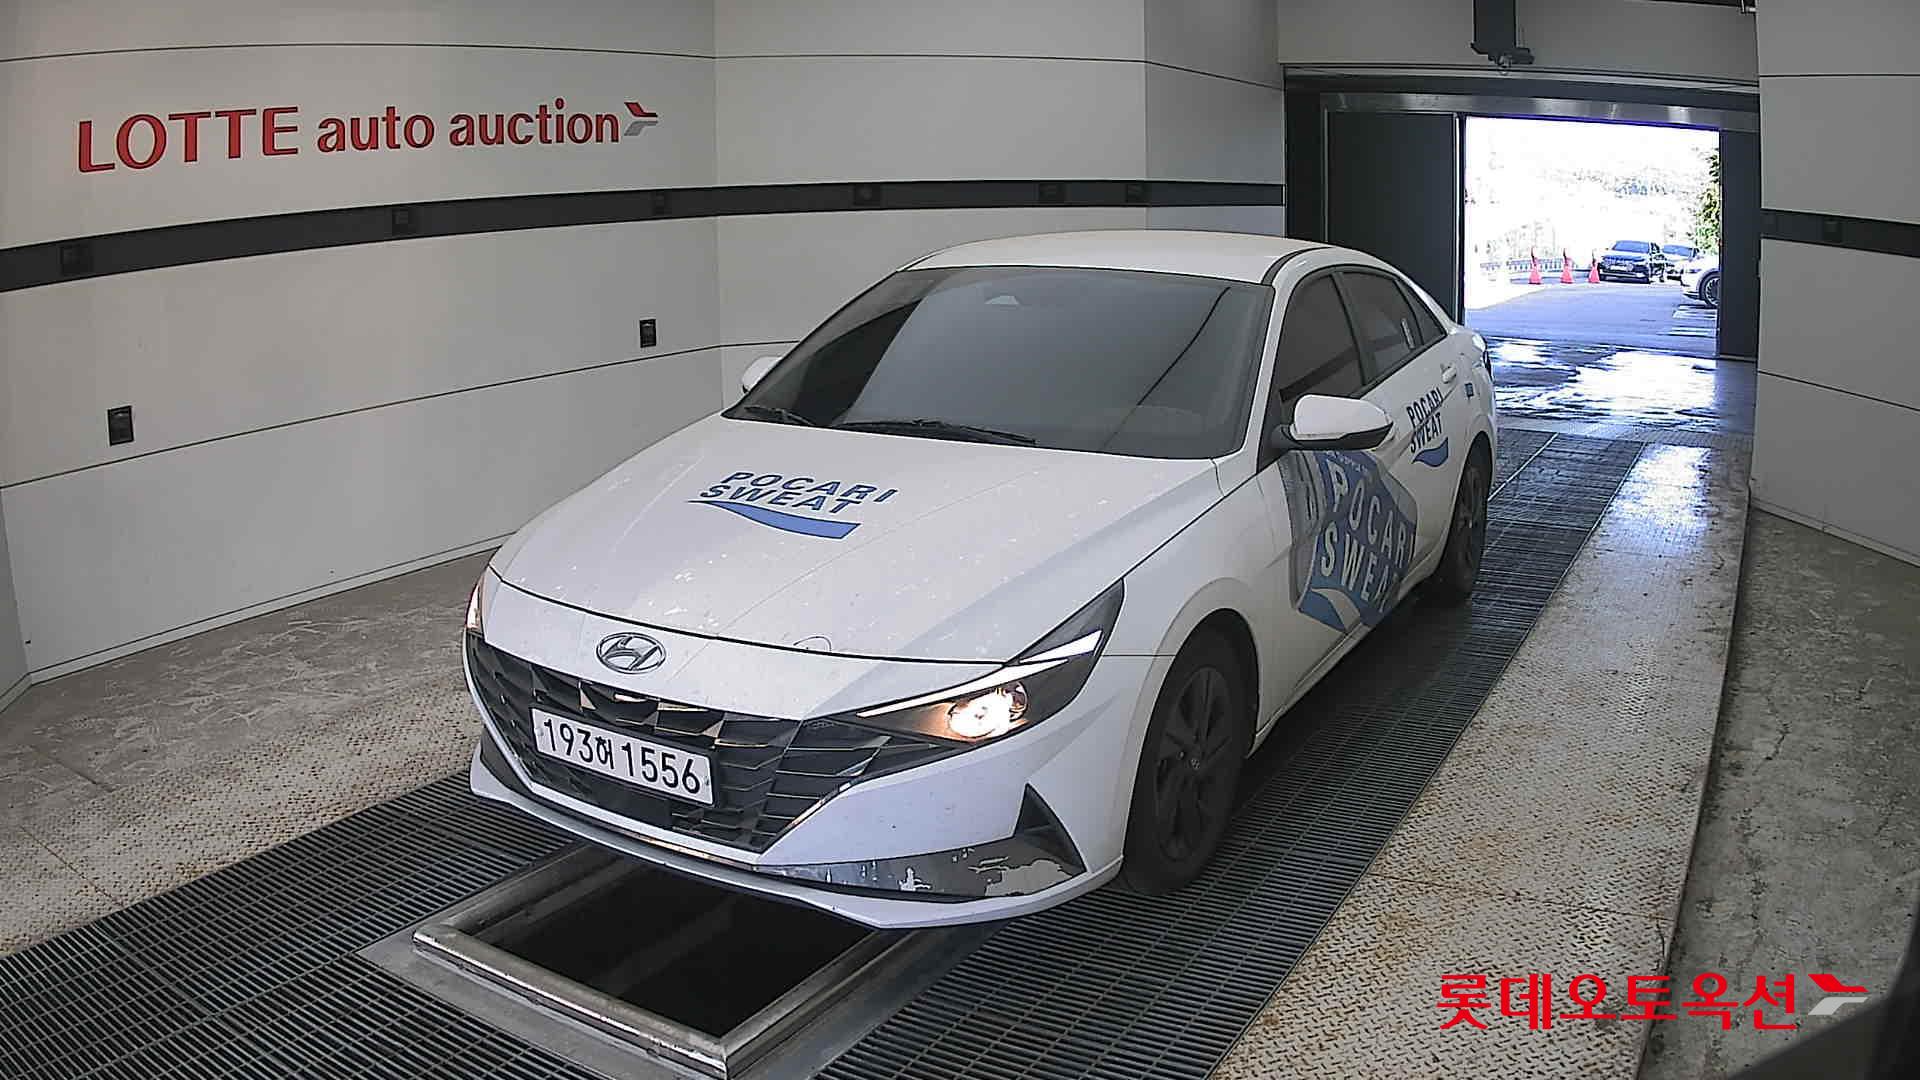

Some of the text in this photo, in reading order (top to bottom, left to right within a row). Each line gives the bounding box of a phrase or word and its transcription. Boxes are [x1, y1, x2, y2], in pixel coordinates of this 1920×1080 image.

[78, 98, 620, 173] LOTTE auto auction
[1406, 387, 1443, 429] POCARI
[1410, 412, 1442, 453] SWEAT
[700, 484, 862, 514] SWEAT
[720, 471, 899, 502] POCARI
[1326, 459, 1415, 569] POCARI
[543, 718, 701, 795] 193허 1556
